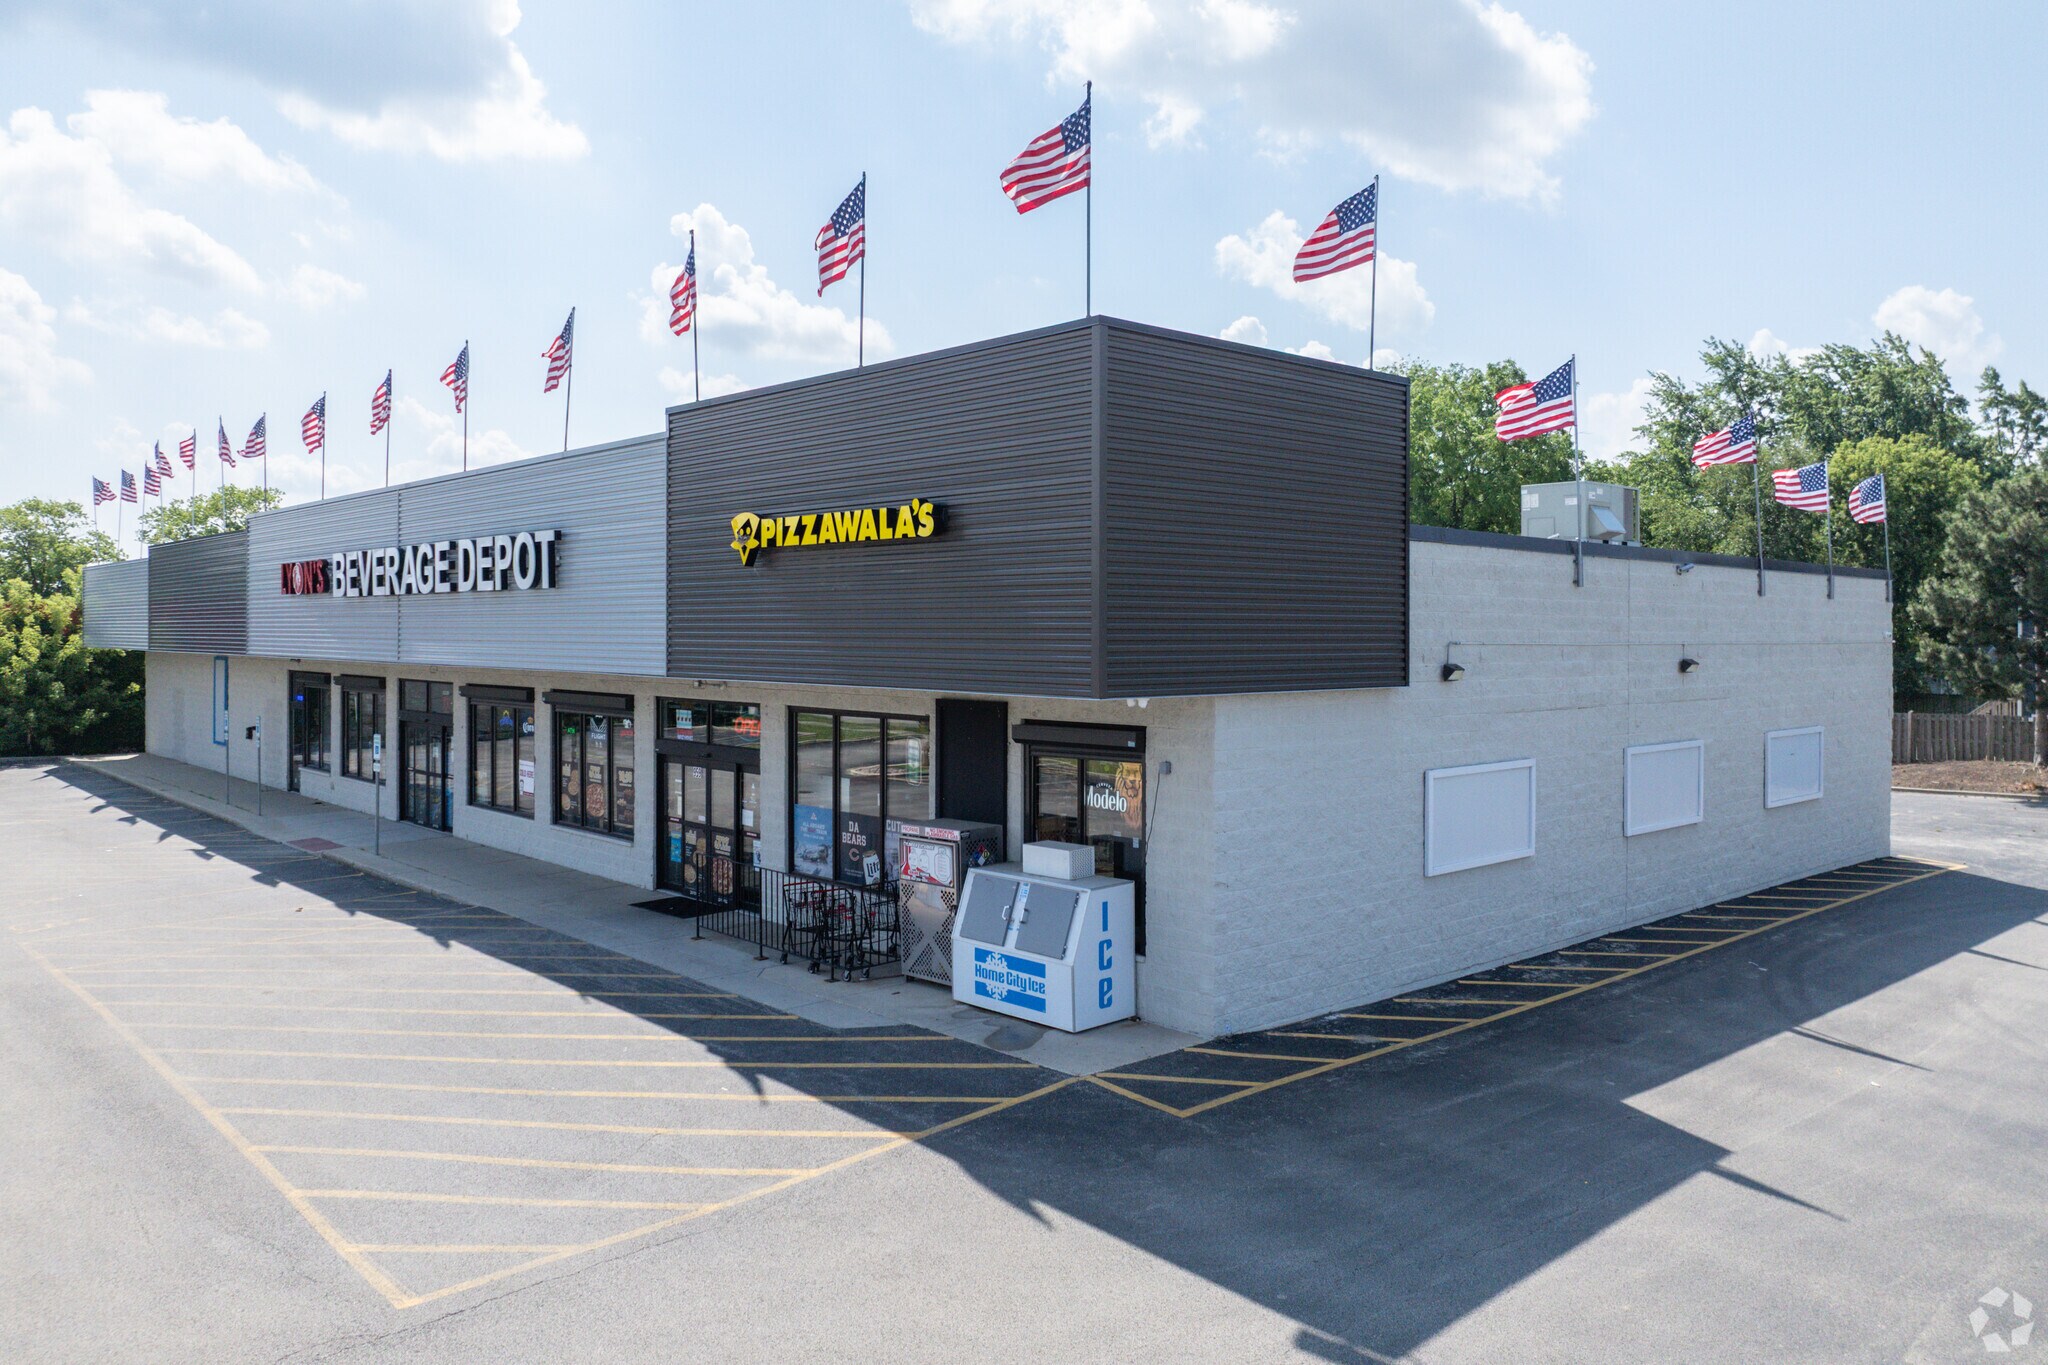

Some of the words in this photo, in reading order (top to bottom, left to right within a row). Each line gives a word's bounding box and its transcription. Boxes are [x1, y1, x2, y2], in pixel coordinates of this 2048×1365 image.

[760, 498, 934, 548] PIZZAWALA'S
[281, 559, 325, 595] LYON'S
[332, 540, 451, 598] BEVERAGE
[458, 530, 556, 592] DEPOT
[591, 732, 607, 740] FLIGHT
[1084, 785, 1127, 813] Modelo
[842, 832, 867, 847] BEARS
[848, 821, 859, 833] DA
[975, 963, 1005, 984] Home
[1006, 971, 1027, 992] City
[1028, 977, 1046, 994] Ice
